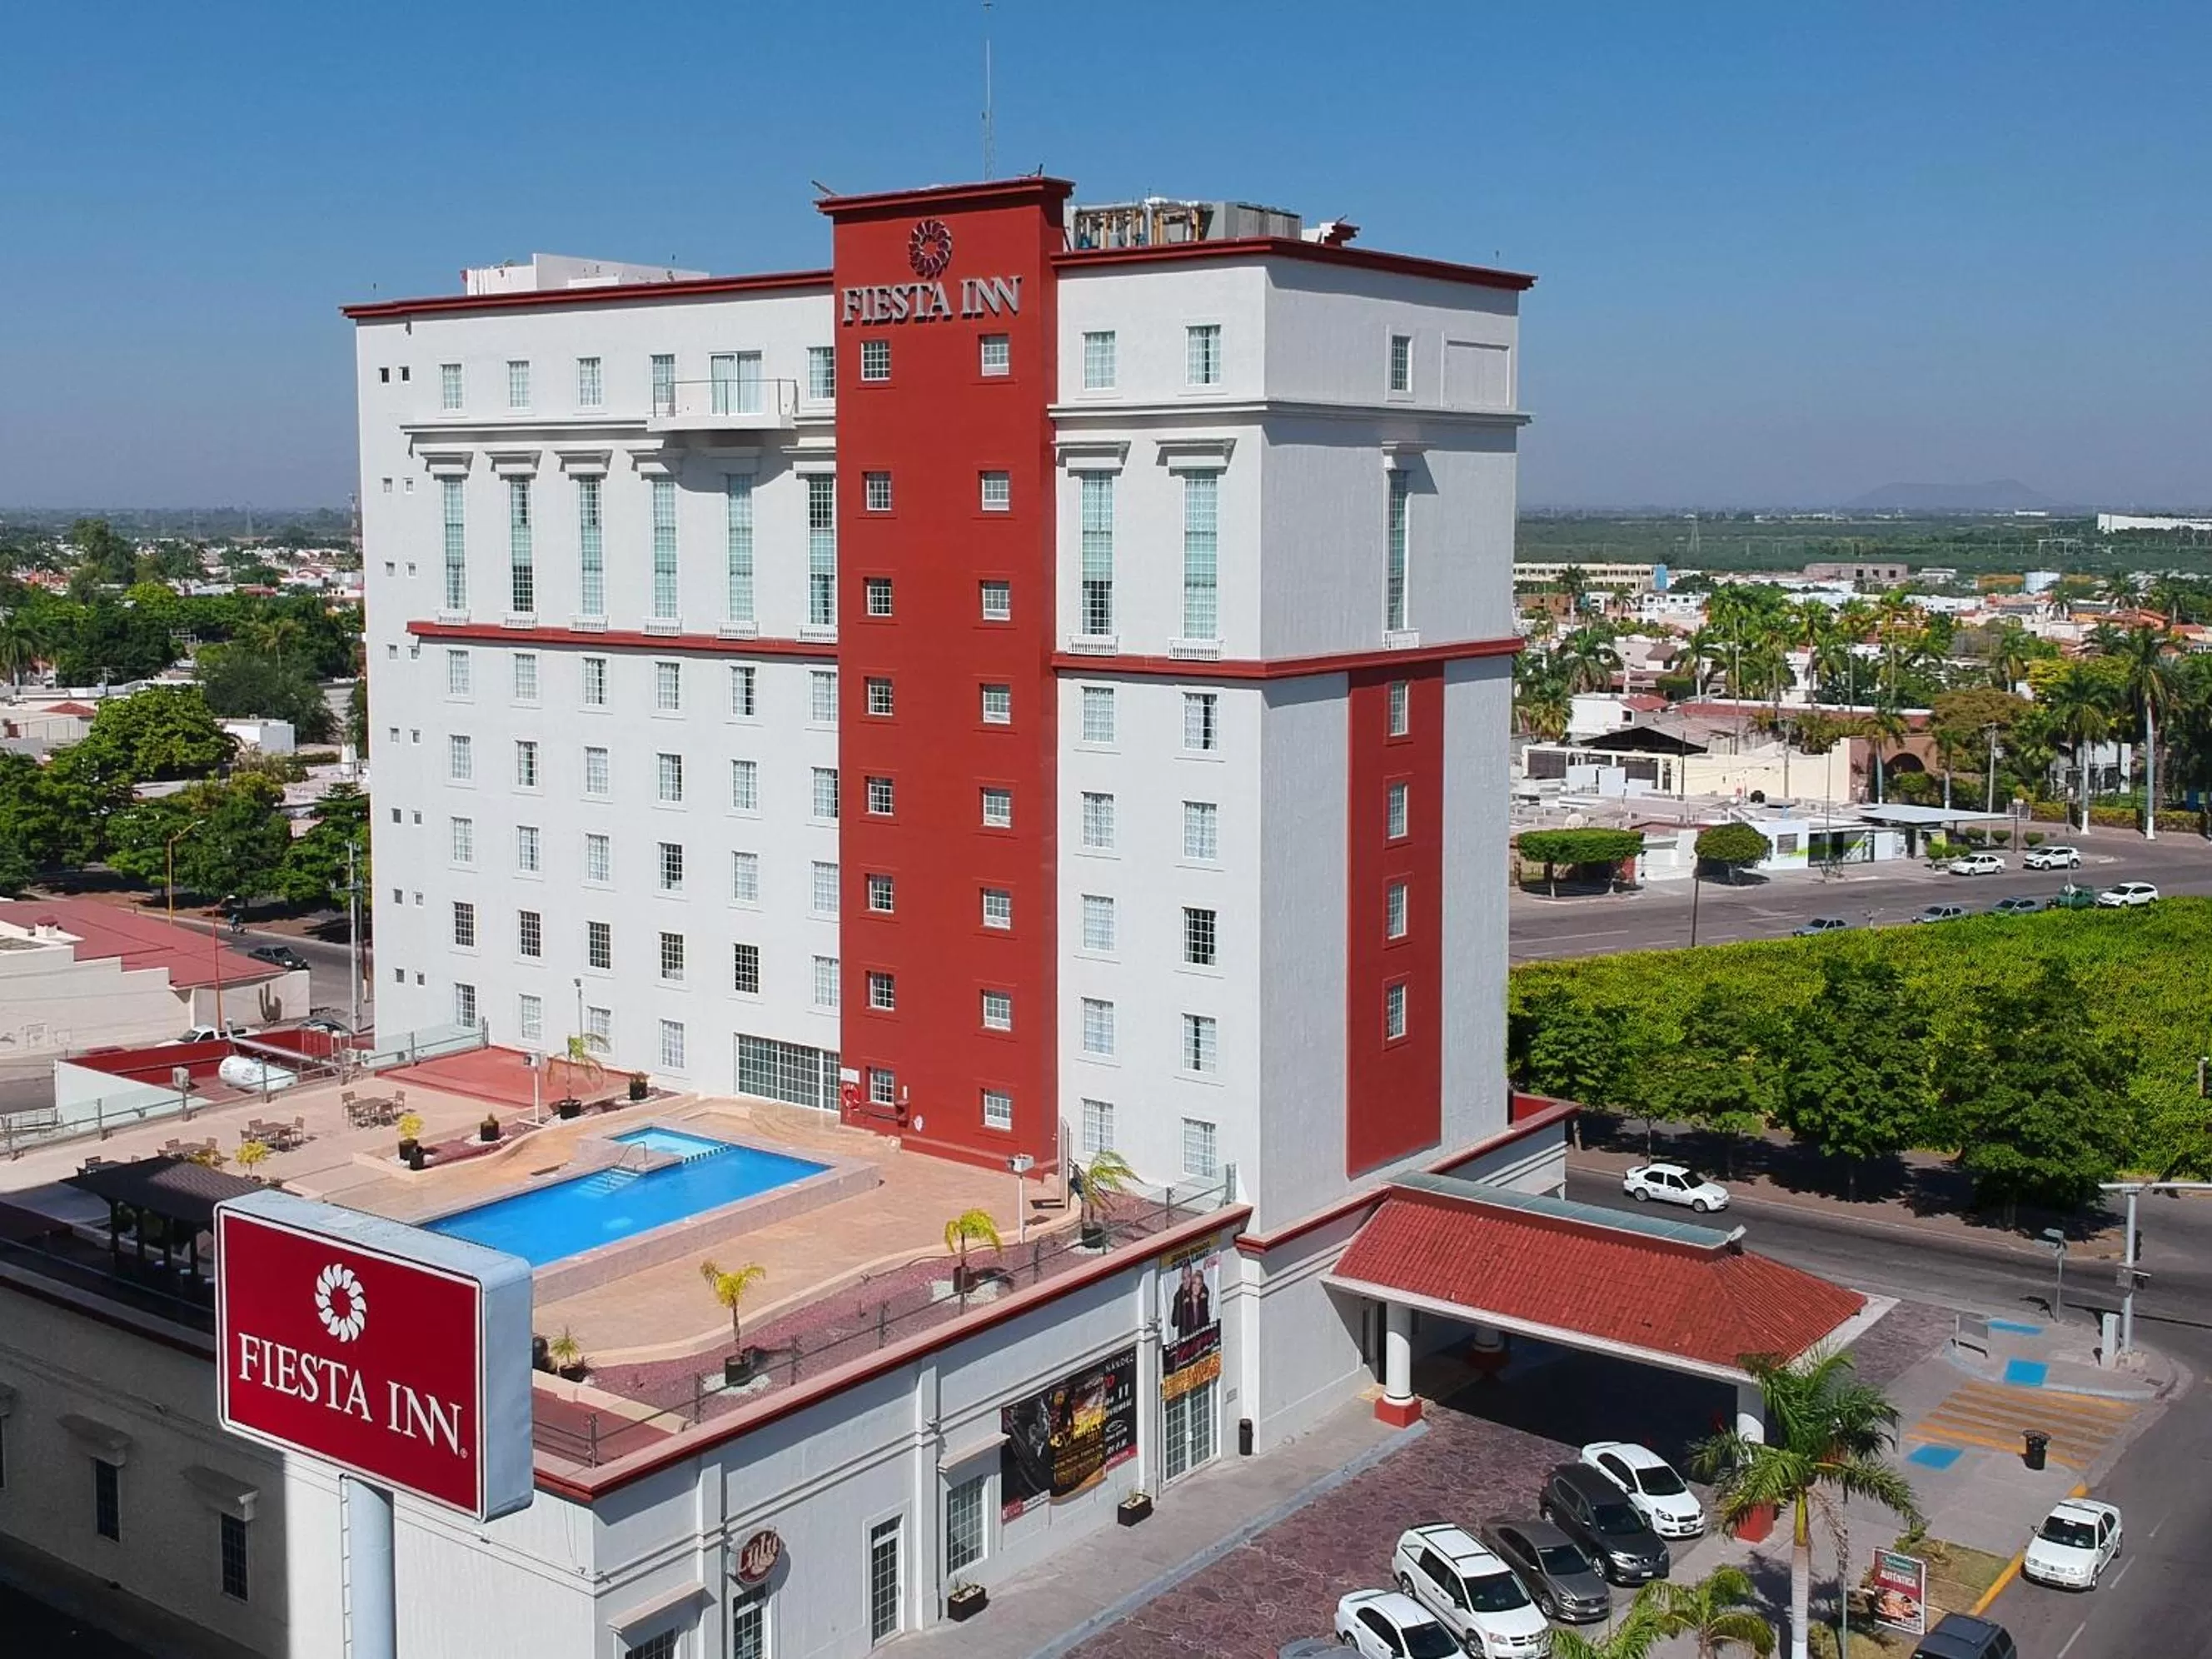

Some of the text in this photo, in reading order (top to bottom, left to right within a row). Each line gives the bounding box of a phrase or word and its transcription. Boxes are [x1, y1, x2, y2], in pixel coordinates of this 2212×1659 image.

[841, 275, 1023, 325] FIESTA INN
[238, 1333, 463, 1457] FIESTA INN
